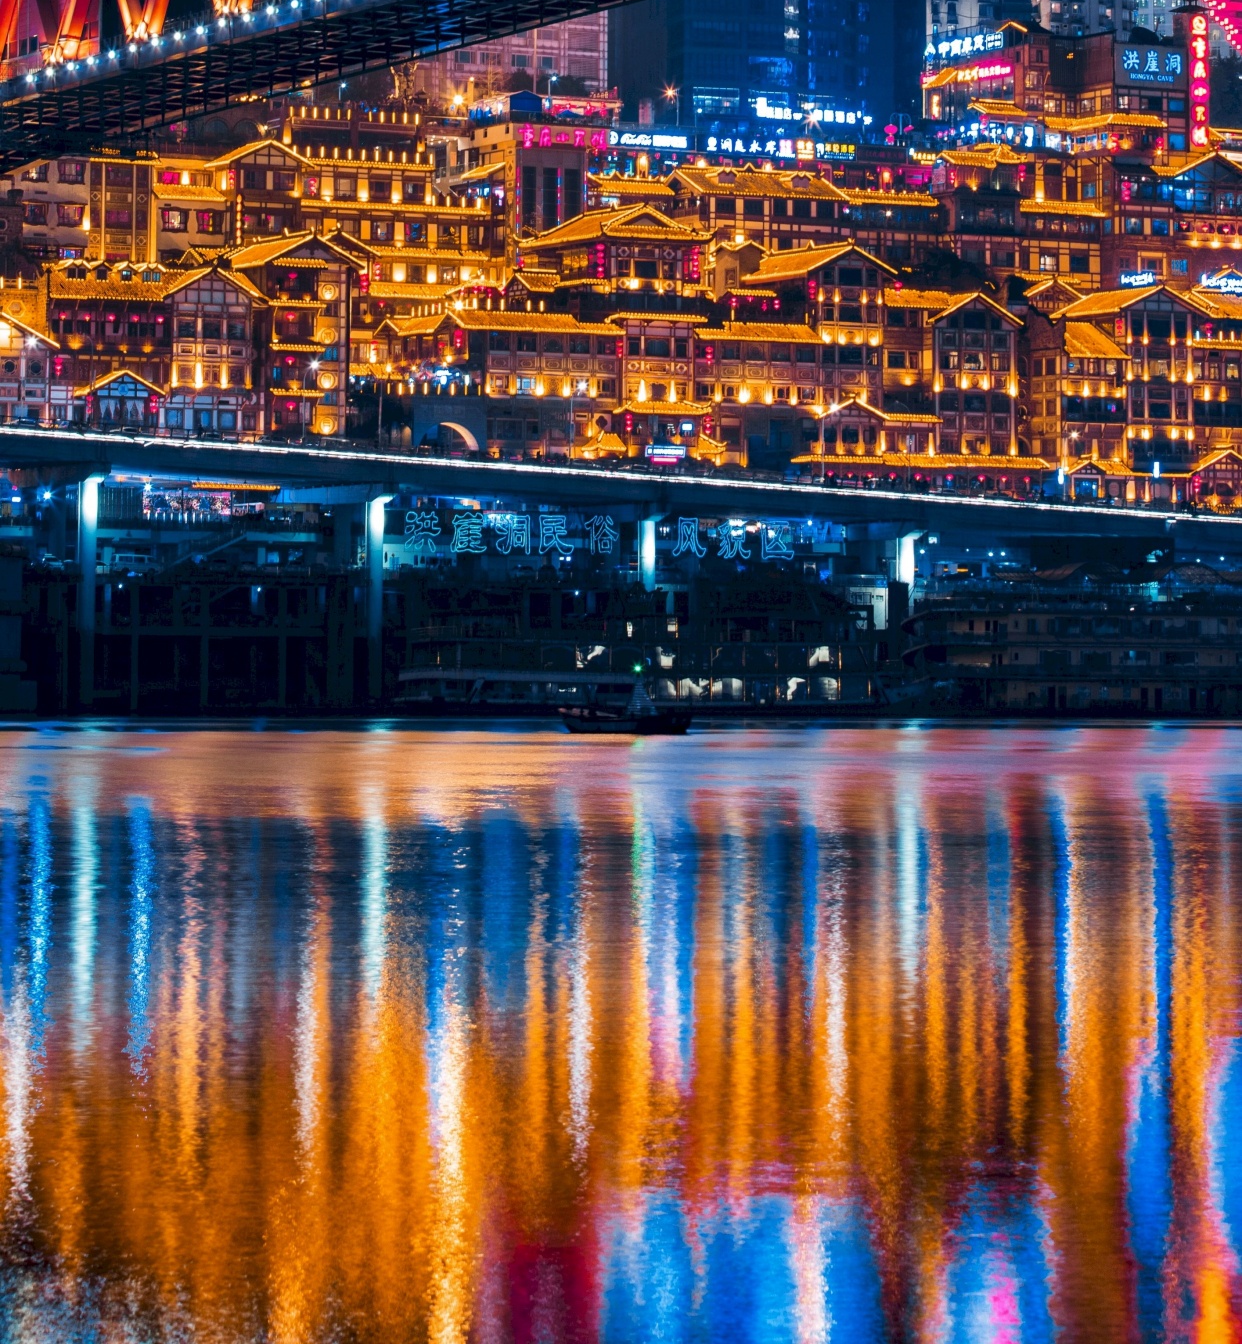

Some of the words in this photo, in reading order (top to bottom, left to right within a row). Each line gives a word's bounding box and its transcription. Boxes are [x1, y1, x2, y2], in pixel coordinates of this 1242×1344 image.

[1122, 49, 1181, 74] 洪崖洞
[1130, 72, 1154, 81] HONGYA
[1157, 74, 1174, 82] CAVE
